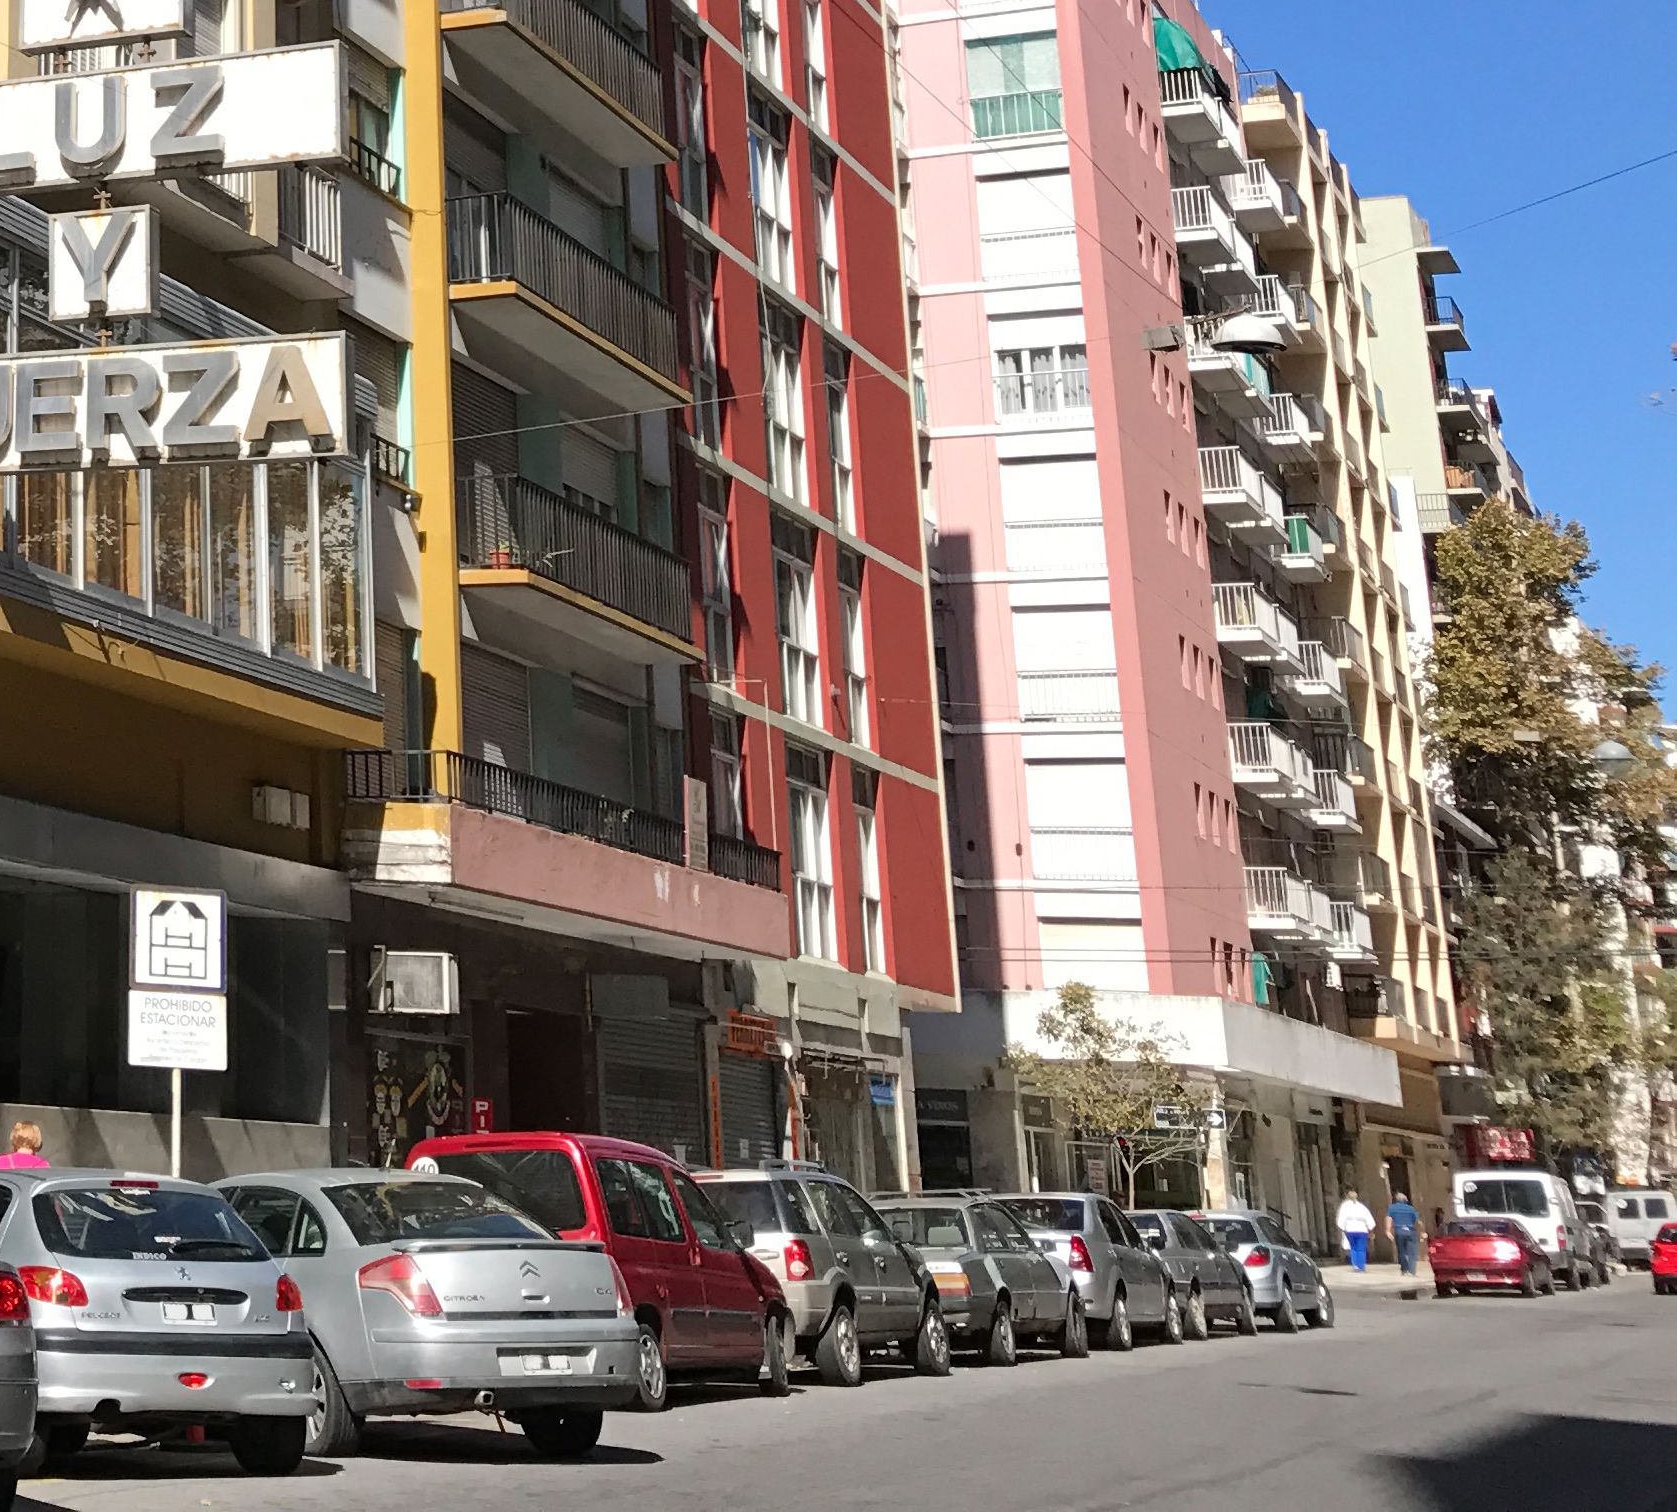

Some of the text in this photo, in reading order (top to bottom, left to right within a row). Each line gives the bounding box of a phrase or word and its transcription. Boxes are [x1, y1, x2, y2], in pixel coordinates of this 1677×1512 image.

[61, 212, 137, 314] Y
[144, 997, 212, 1013] PROHIBIDO
[140, 1012, 216, 1028] ESTACIONAR
